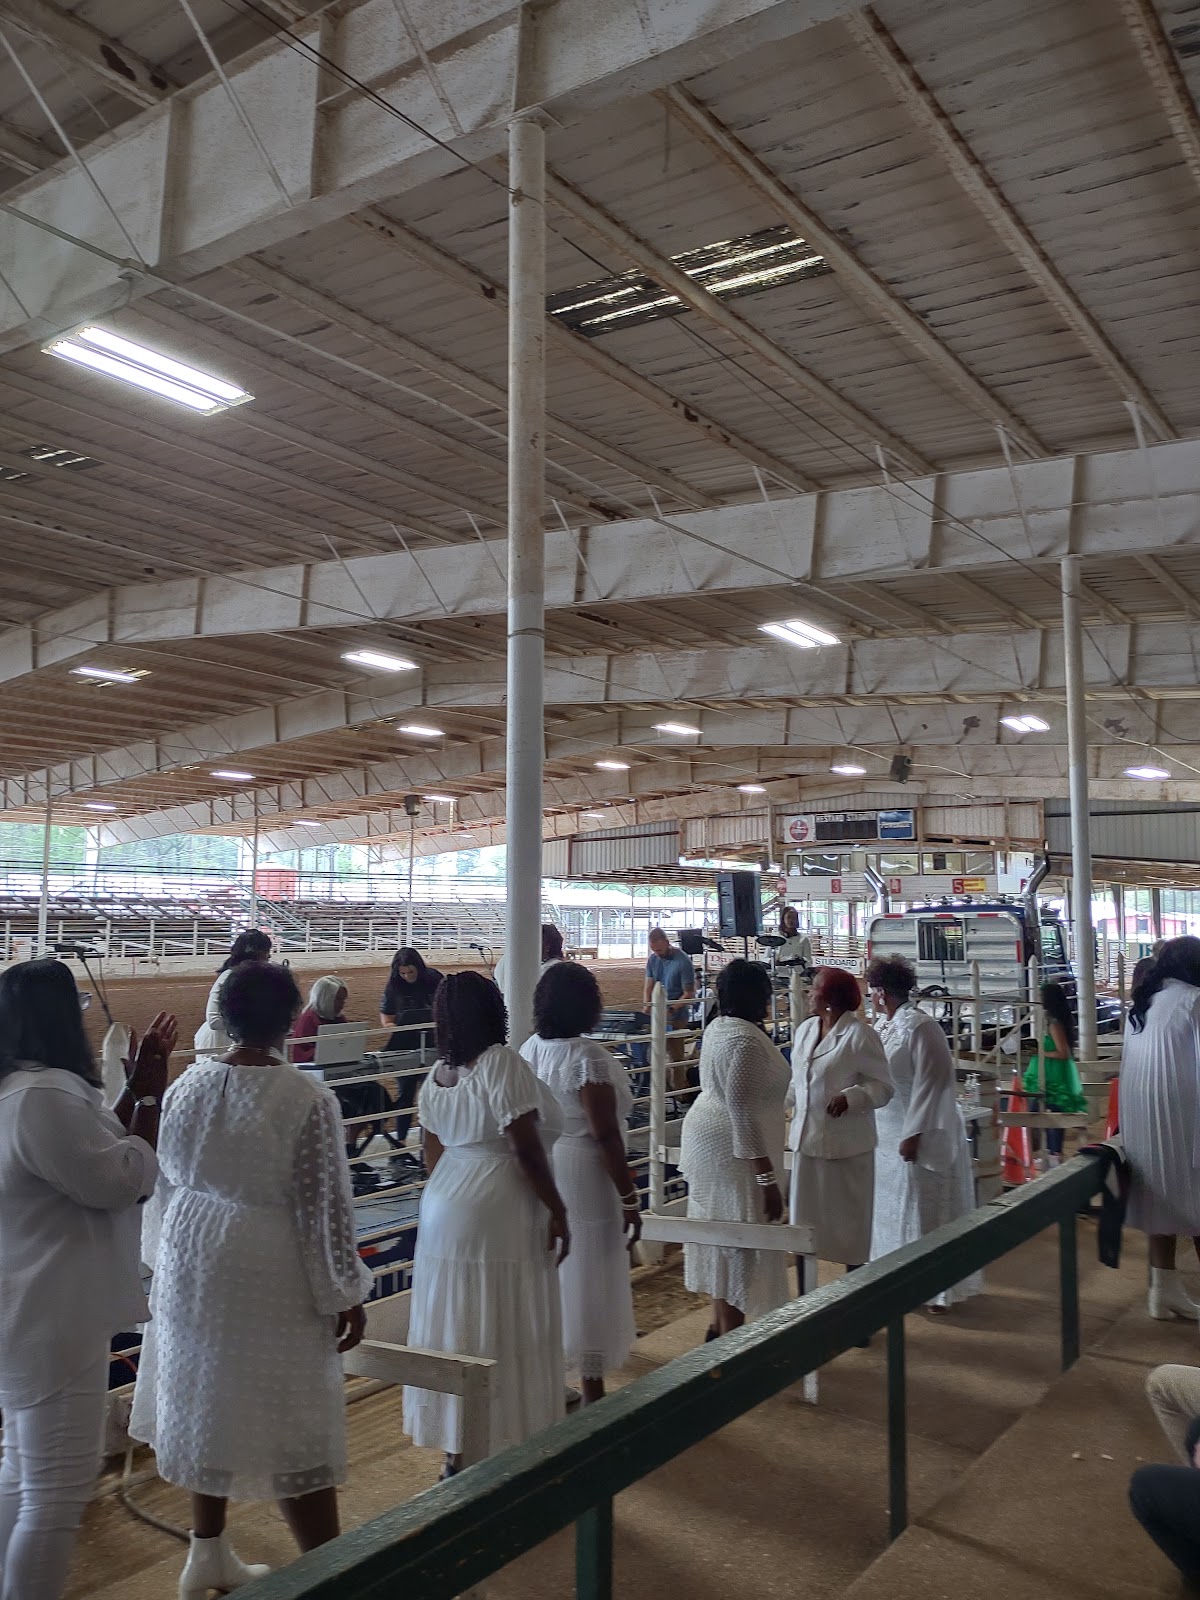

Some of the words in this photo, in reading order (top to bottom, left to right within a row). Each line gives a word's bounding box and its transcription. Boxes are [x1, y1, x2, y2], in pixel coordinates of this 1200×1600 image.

[832, 880, 840, 892] 3
[953, 880, 963, 893] 5
[815, 957, 858, 967] STUDDARD
